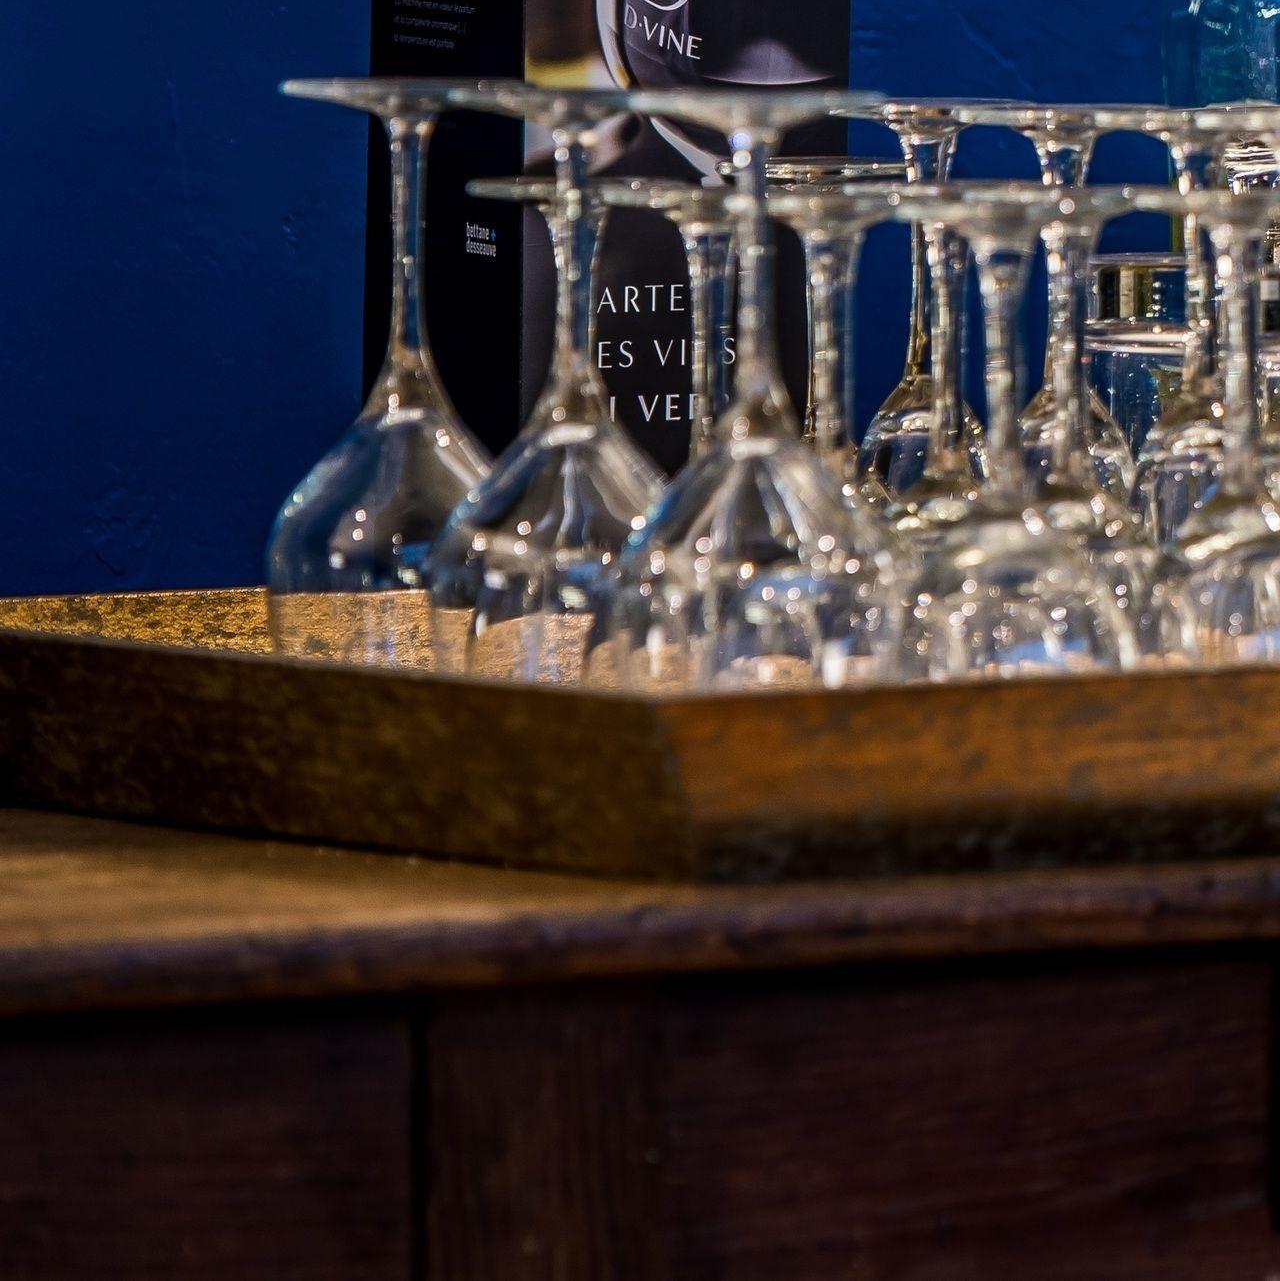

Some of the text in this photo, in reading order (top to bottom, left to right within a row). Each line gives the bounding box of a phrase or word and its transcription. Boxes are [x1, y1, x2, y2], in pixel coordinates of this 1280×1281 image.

[465, 221, 490, 240] bettane
[597, 284, 685, 313] ARTE
[598, 338, 736, 369] ES VIS
